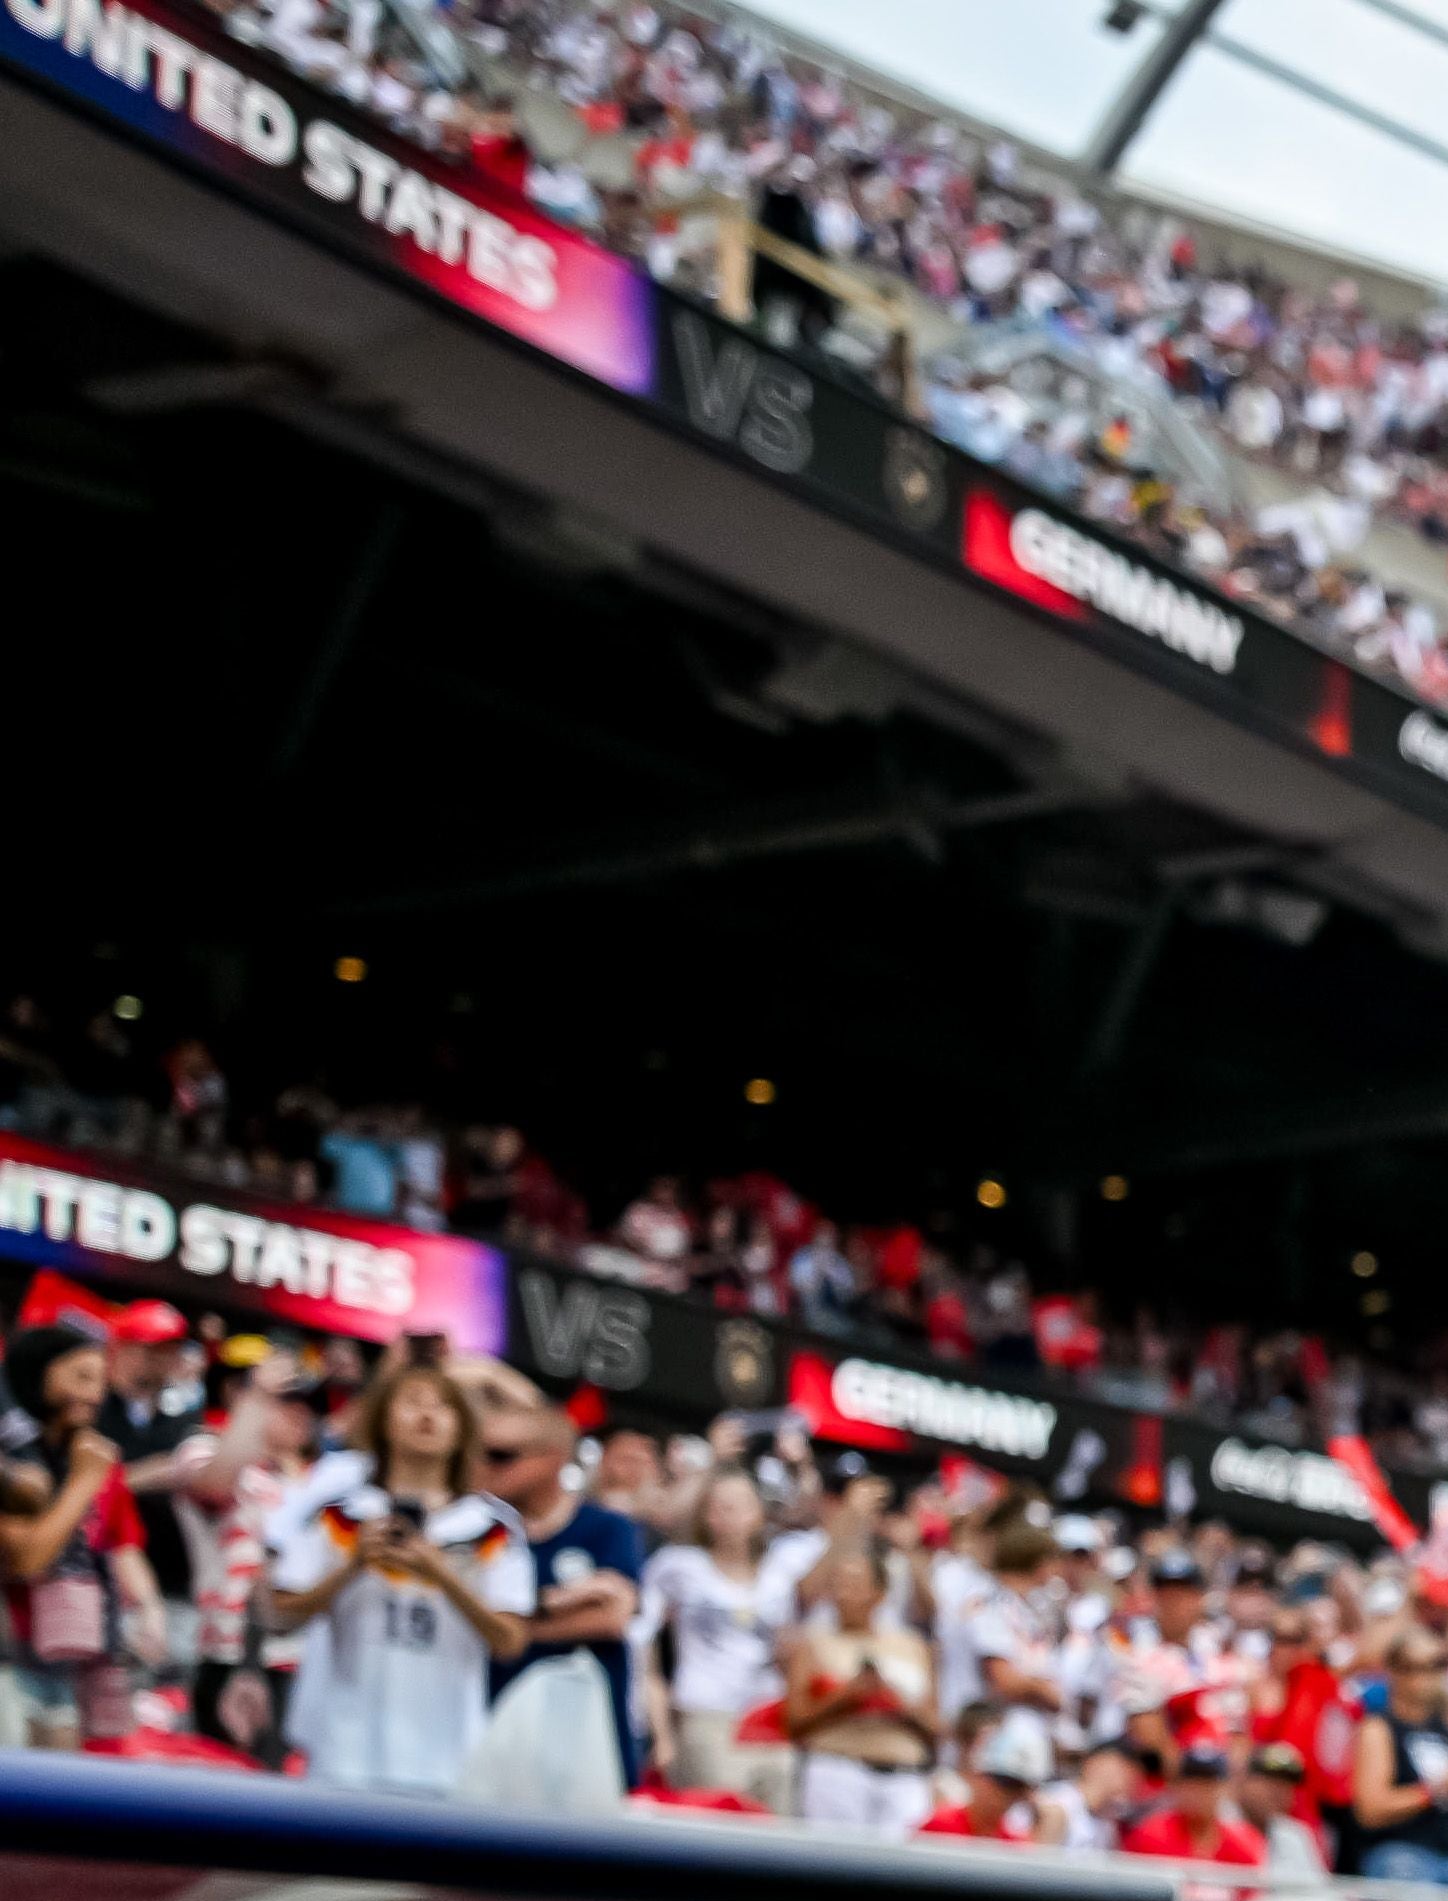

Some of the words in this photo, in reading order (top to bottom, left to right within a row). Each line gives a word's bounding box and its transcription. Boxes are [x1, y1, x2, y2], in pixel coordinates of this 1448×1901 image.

[302, 119, 559, 311] STATES
[672, 308, 815, 474] VS
[179, 1203, 414, 1314] STATES
[518, 1269, 652, 1392] VS
